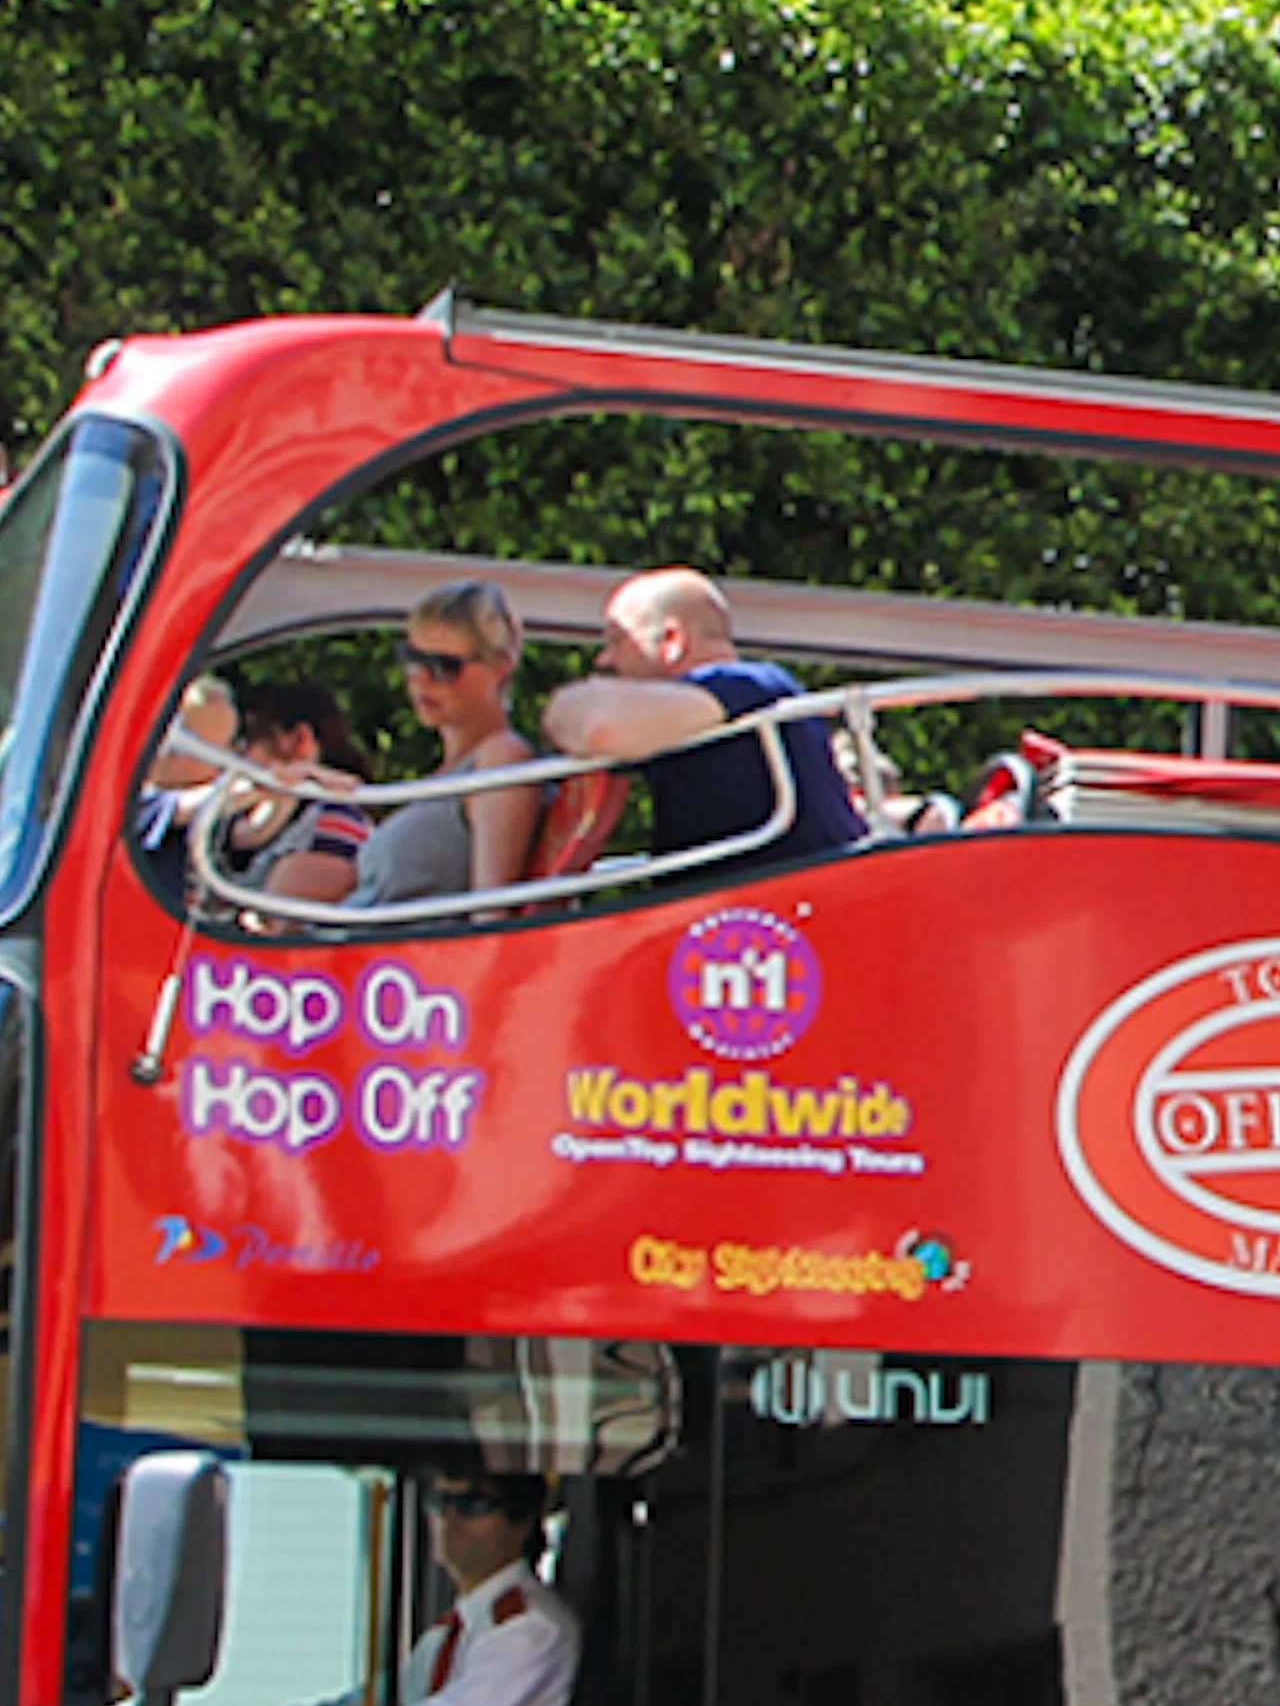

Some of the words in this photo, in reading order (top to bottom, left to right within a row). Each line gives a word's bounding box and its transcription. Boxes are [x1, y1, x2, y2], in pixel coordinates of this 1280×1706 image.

[191, 960, 344, 1047] Hop
[363, 963, 463, 1045] On
[190, 1060, 343, 1150] Hop
[360, 1062, 479, 1145] Off
[566, 1068, 911, 1138] Worldwide
